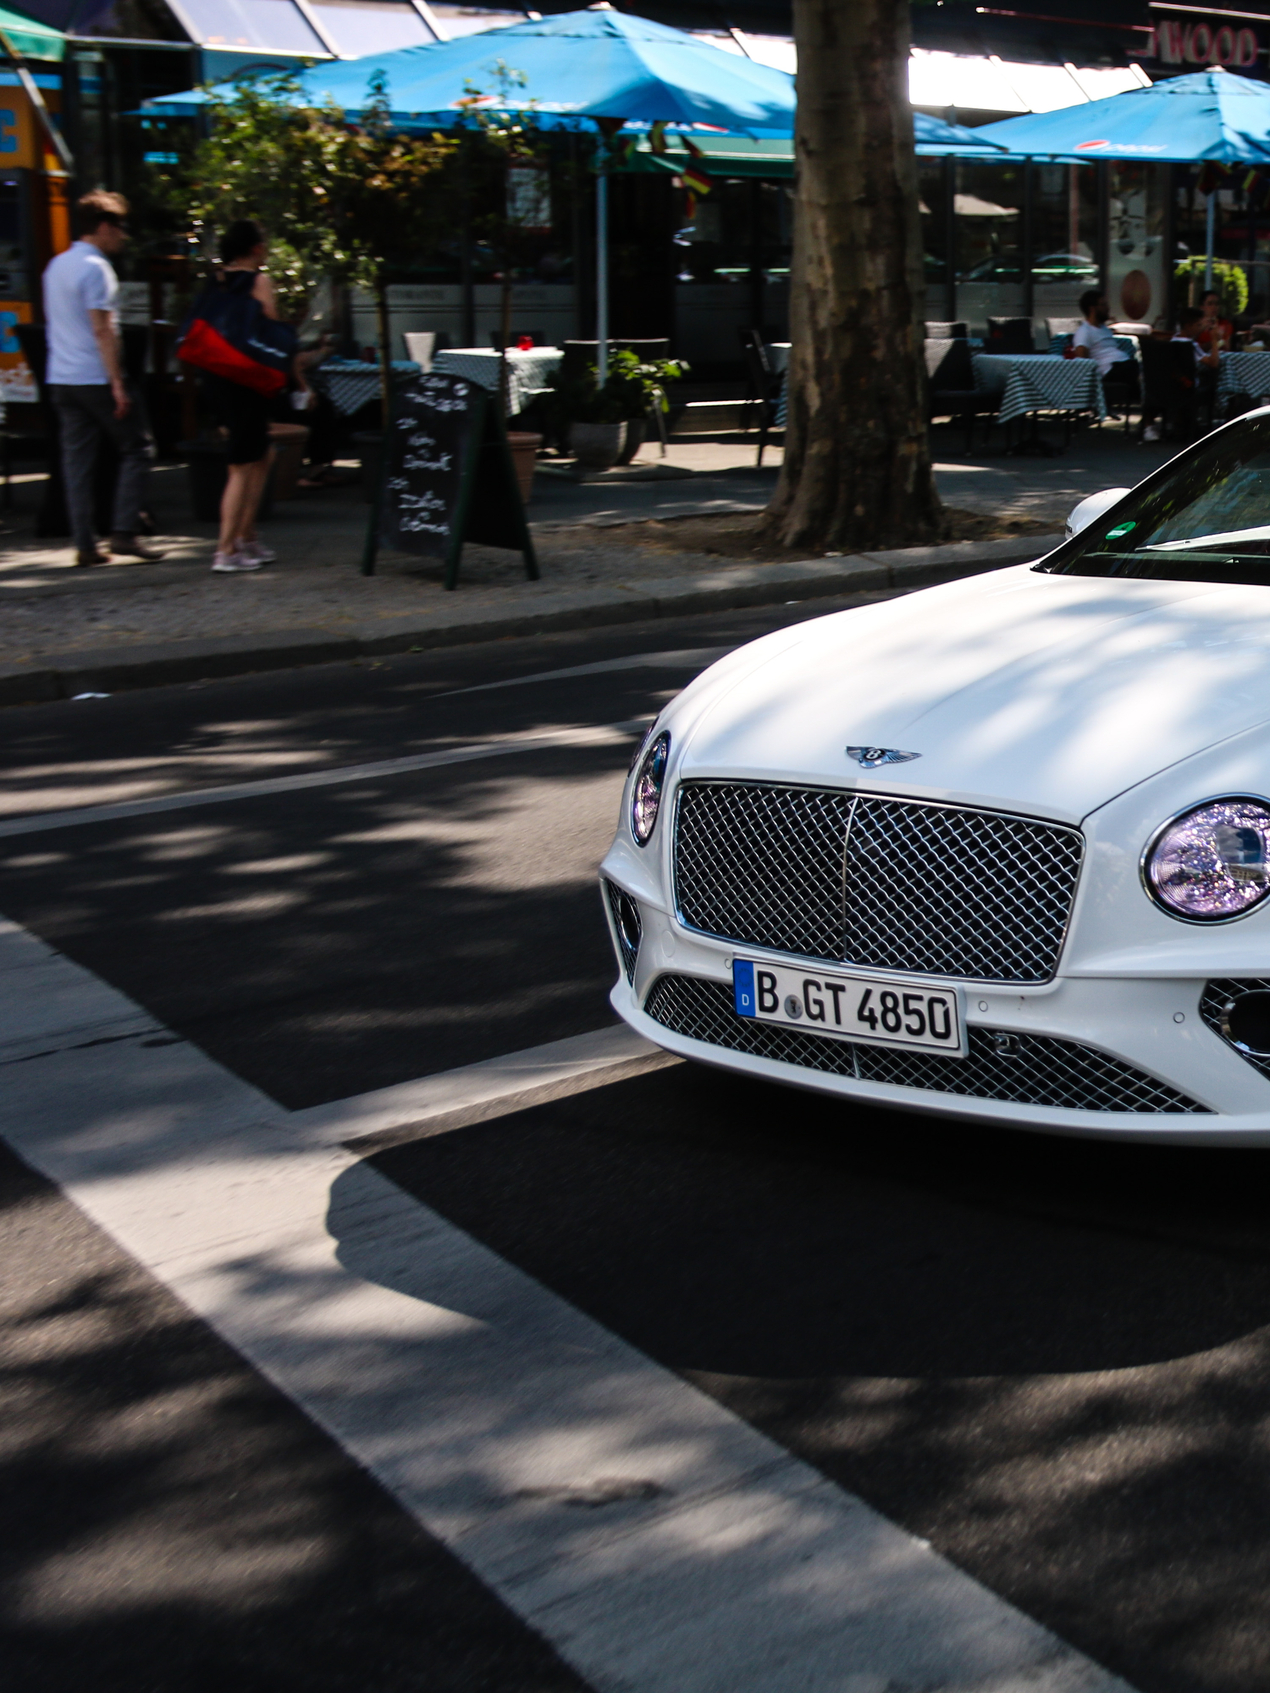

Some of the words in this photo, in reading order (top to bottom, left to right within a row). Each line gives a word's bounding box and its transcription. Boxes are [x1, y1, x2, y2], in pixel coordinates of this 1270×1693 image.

[741, 994, 750, 1006] D
[757, 969, 779, 1013] B
[803, 978, 847, 1025] GT
[857, 987, 952, 1040] 4850
